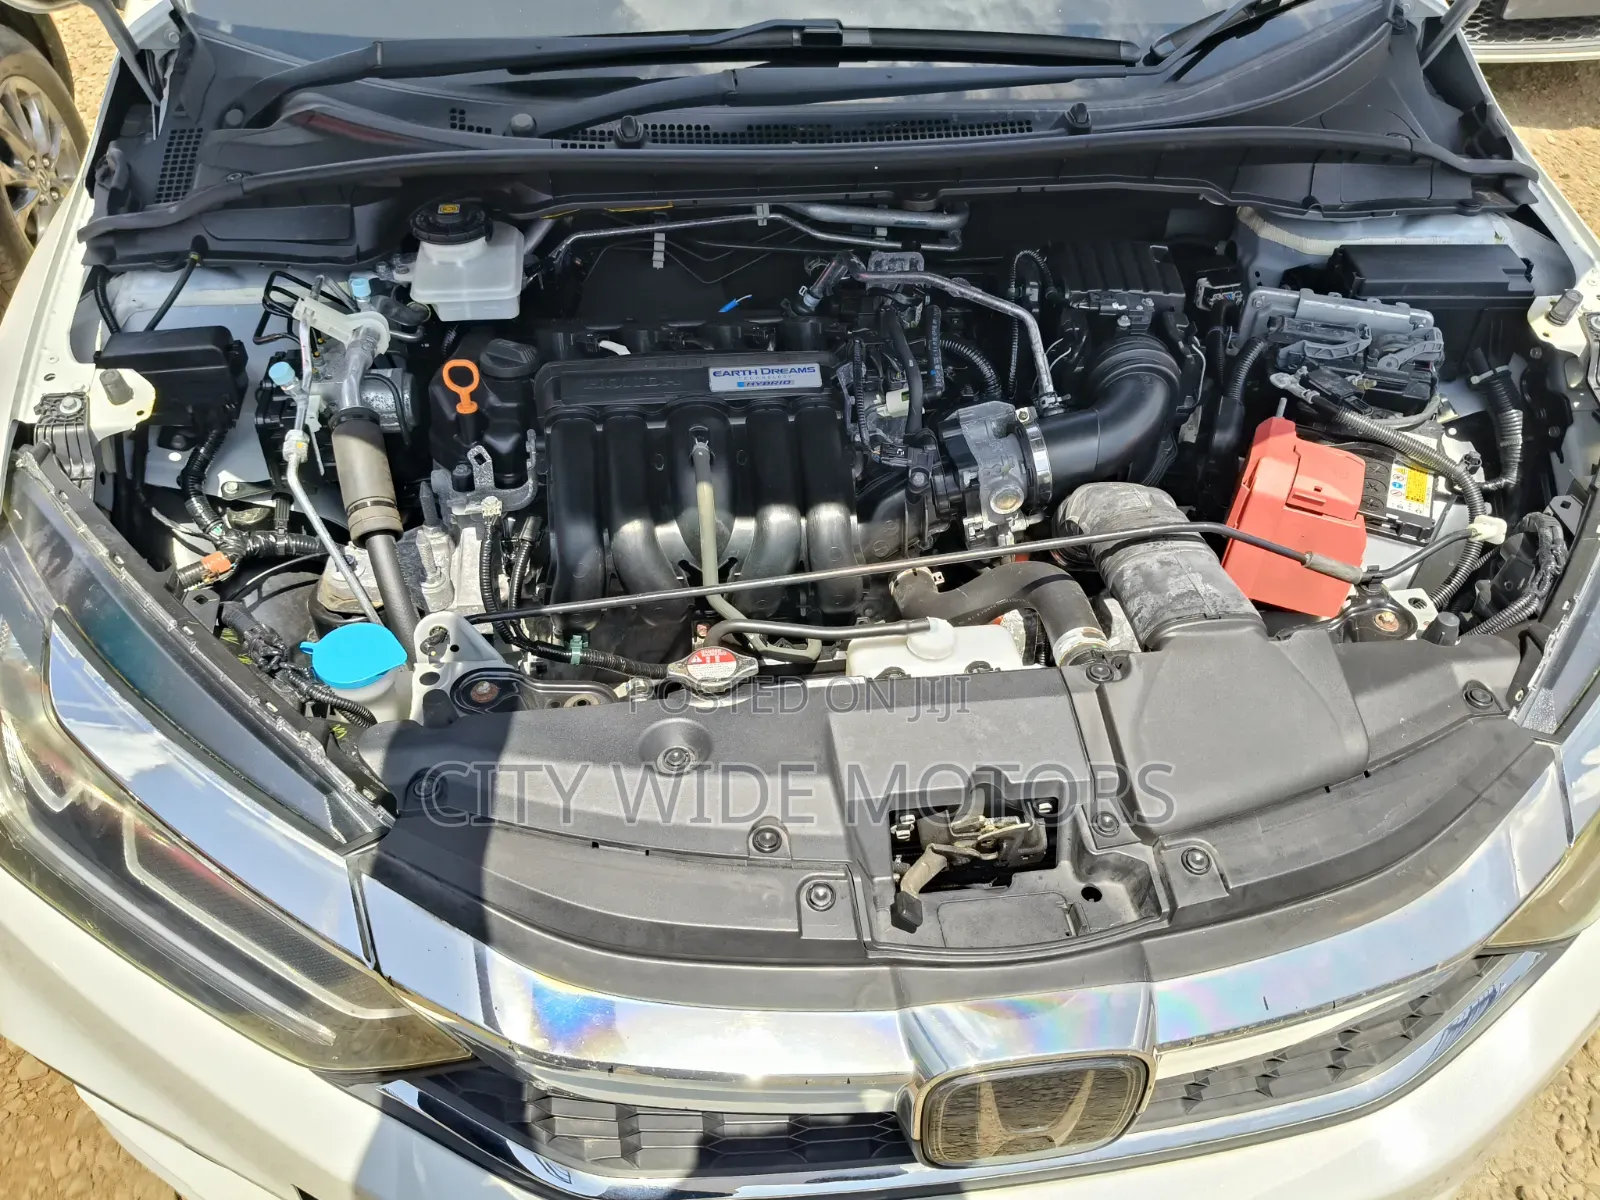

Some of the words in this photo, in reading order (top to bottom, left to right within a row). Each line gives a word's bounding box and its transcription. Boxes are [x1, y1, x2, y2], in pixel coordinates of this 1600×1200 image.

[712, 369, 758, 377] EARTH
[760, 366, 816, 375] DREAMS
[746, 379, 791, 387] HYBRID
